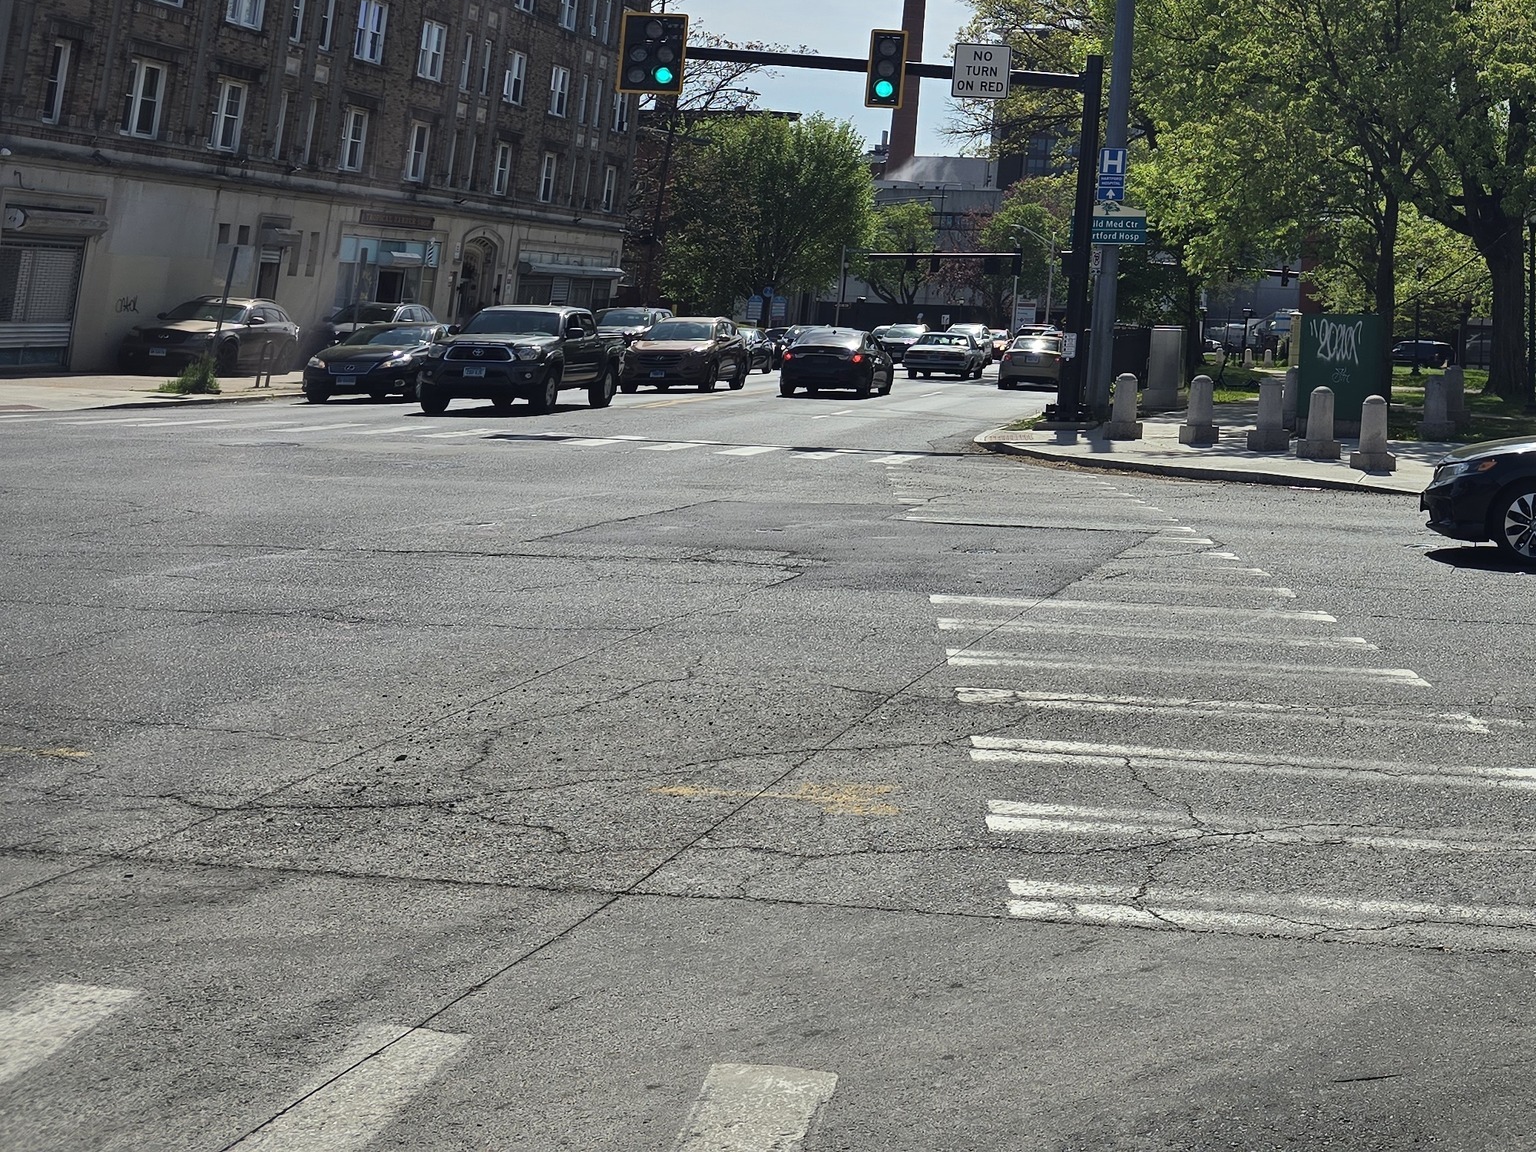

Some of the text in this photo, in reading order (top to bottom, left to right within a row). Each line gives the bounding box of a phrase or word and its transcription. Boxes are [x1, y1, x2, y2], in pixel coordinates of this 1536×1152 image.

[973, 51, 993, 61] NO
[966, 66, 998, 77] TURN
[957, 80, 1004, 92] ON RED
[1102, 150, 1124, 174] H
[1105, 220, 1124, 228] Med
[1125, 220, 1139, 228] Ctr
[1092, 232, 1140, 241] rtford Hosp
